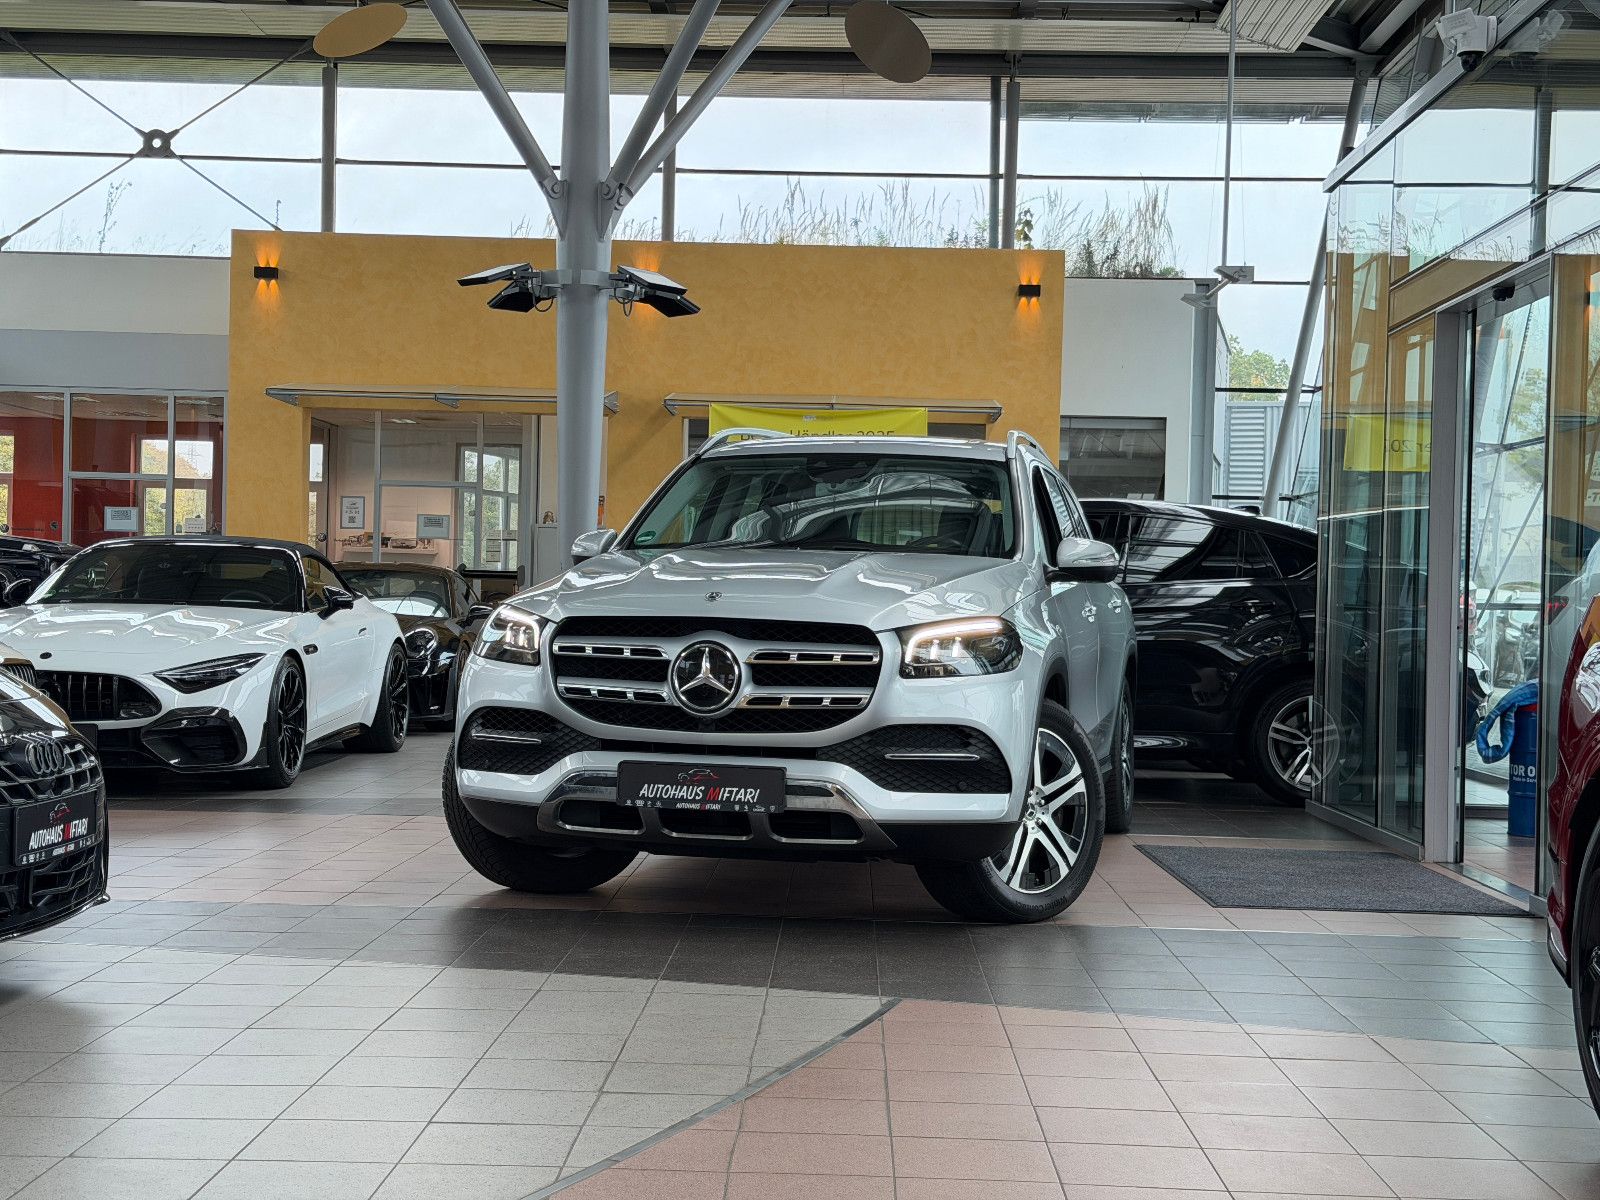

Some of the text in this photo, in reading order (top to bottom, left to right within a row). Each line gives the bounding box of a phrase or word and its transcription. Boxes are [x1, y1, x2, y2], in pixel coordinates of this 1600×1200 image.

[790, 429, 853, 437] Hädl
[639, 783, 760, 803] AUTOHAUS MIFTARI
[29, 823, 64, 851] AUTOHAUS
[64, 817, 89, 840] MIFTARI
